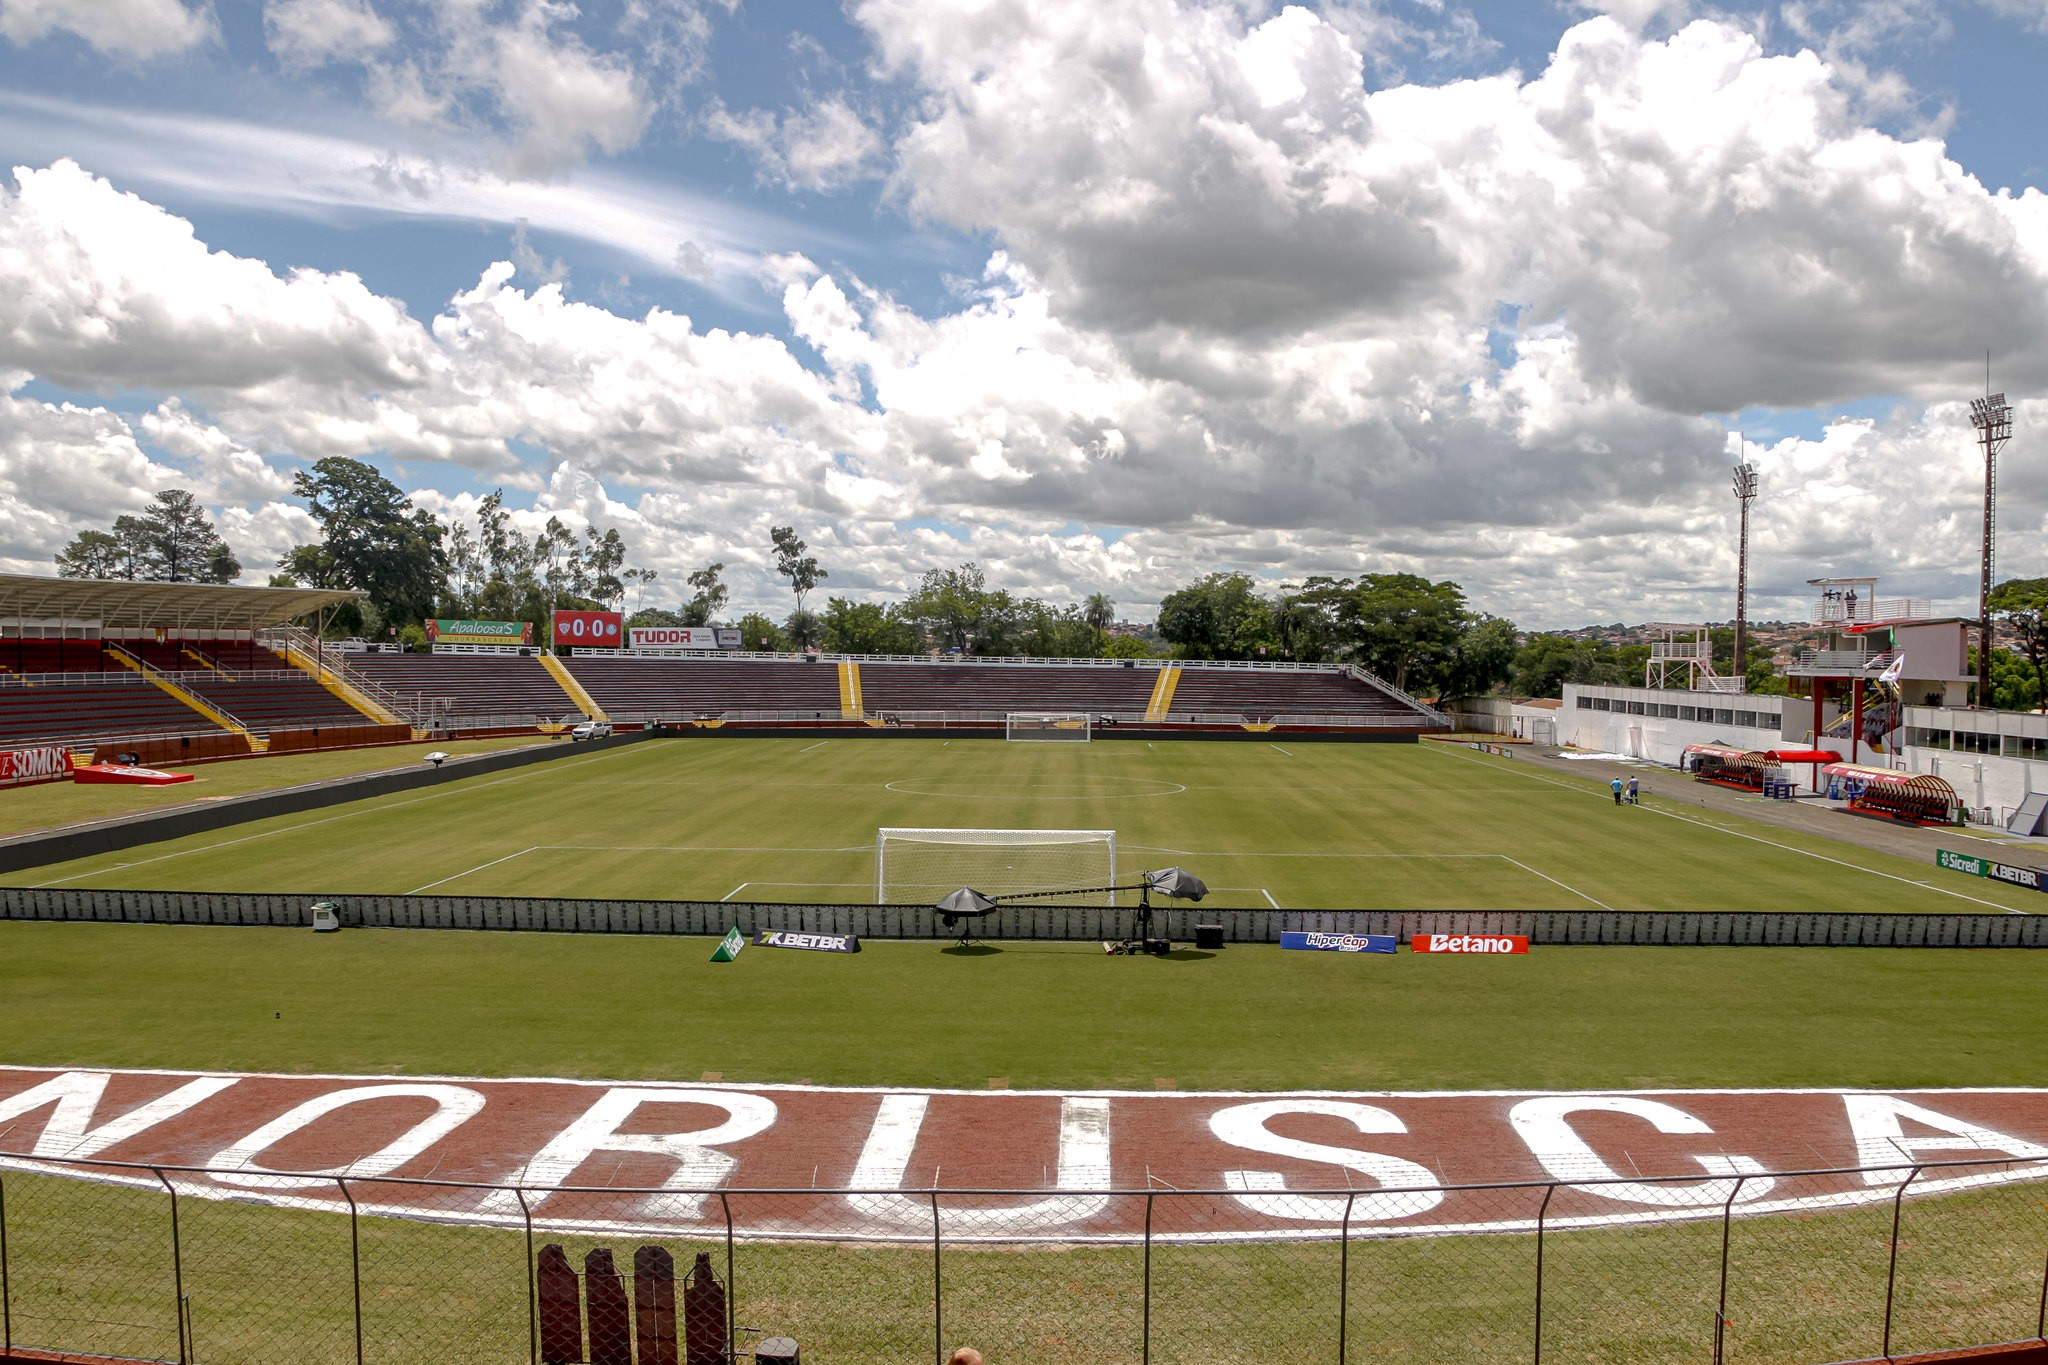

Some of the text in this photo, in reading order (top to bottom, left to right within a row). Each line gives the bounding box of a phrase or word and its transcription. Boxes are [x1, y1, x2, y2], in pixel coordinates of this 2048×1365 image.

[572, 619, 584, 637] 0
[592, 619, 604, 637] 0
[632, 630, 691, 643] TUDOR
[12, 748, 66, 778] SOMOS
[1949, 853, 1980, 874] Sicredi
[1307, 933, 1368, 948] HiperCap
[1430, 935, 1512, 952] Betano
